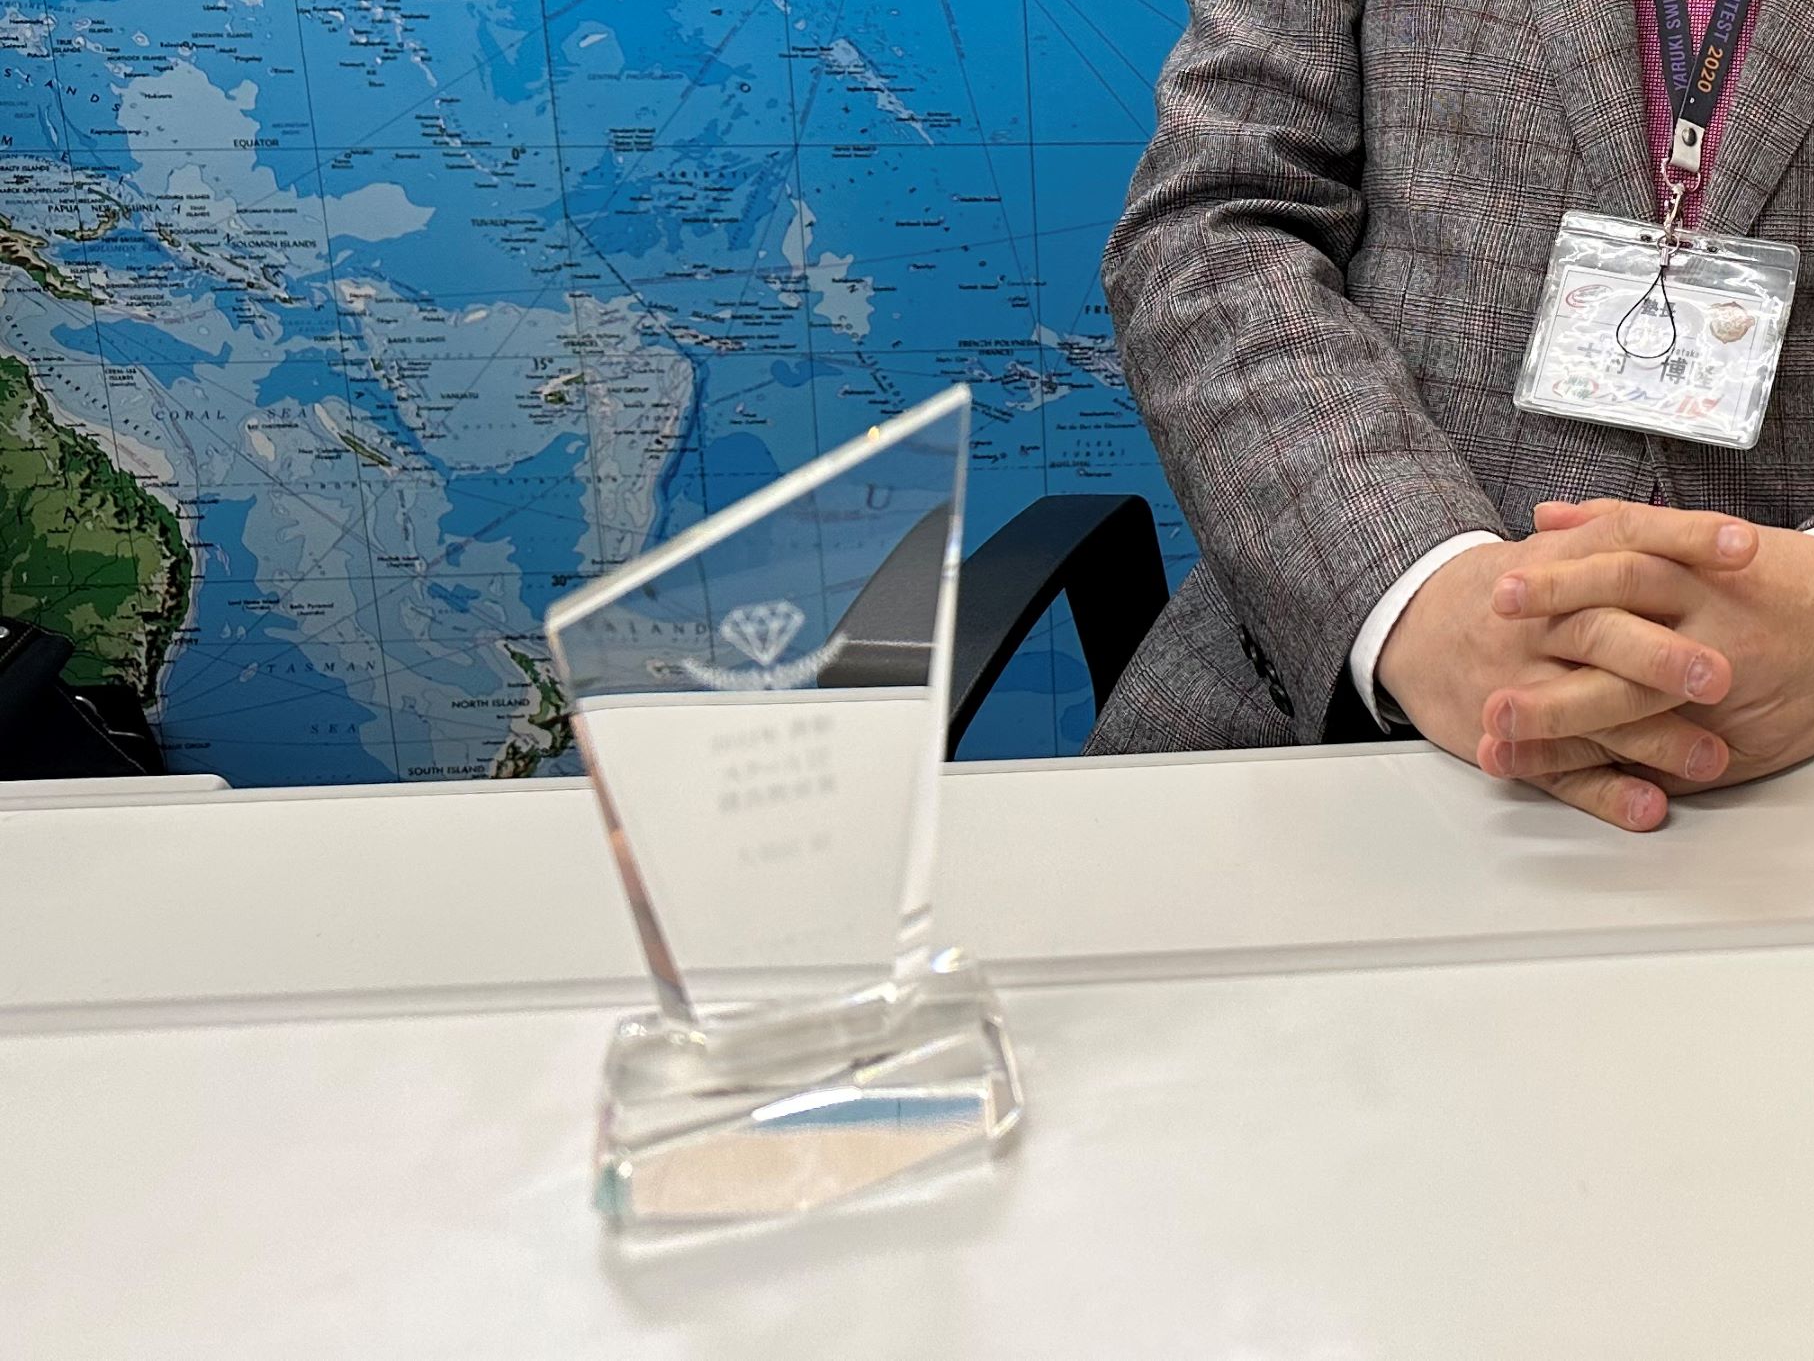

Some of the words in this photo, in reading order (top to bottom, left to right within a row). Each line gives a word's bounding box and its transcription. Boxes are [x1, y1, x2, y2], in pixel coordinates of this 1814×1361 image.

[1668, 34, 1687, 91] YARUKI
[1697, 44, 1723, 93] 2020
[234, 140, 279, 148] EQUATOR
[512, 147, 526, 160] 0°
[281, 240, 317, 249] ISLANDS
[155, 410, 226, 421] CORAL
[267, 408, 308, 418] SEA
[267, 661, 376, 672] TASMAN
[492, 698, 529, 708] ISLAND
[311, 724, 357, 735] SEA
[408, 767, 444, 776] SOUTH
[448, 765, 485, 775] ISLAND
